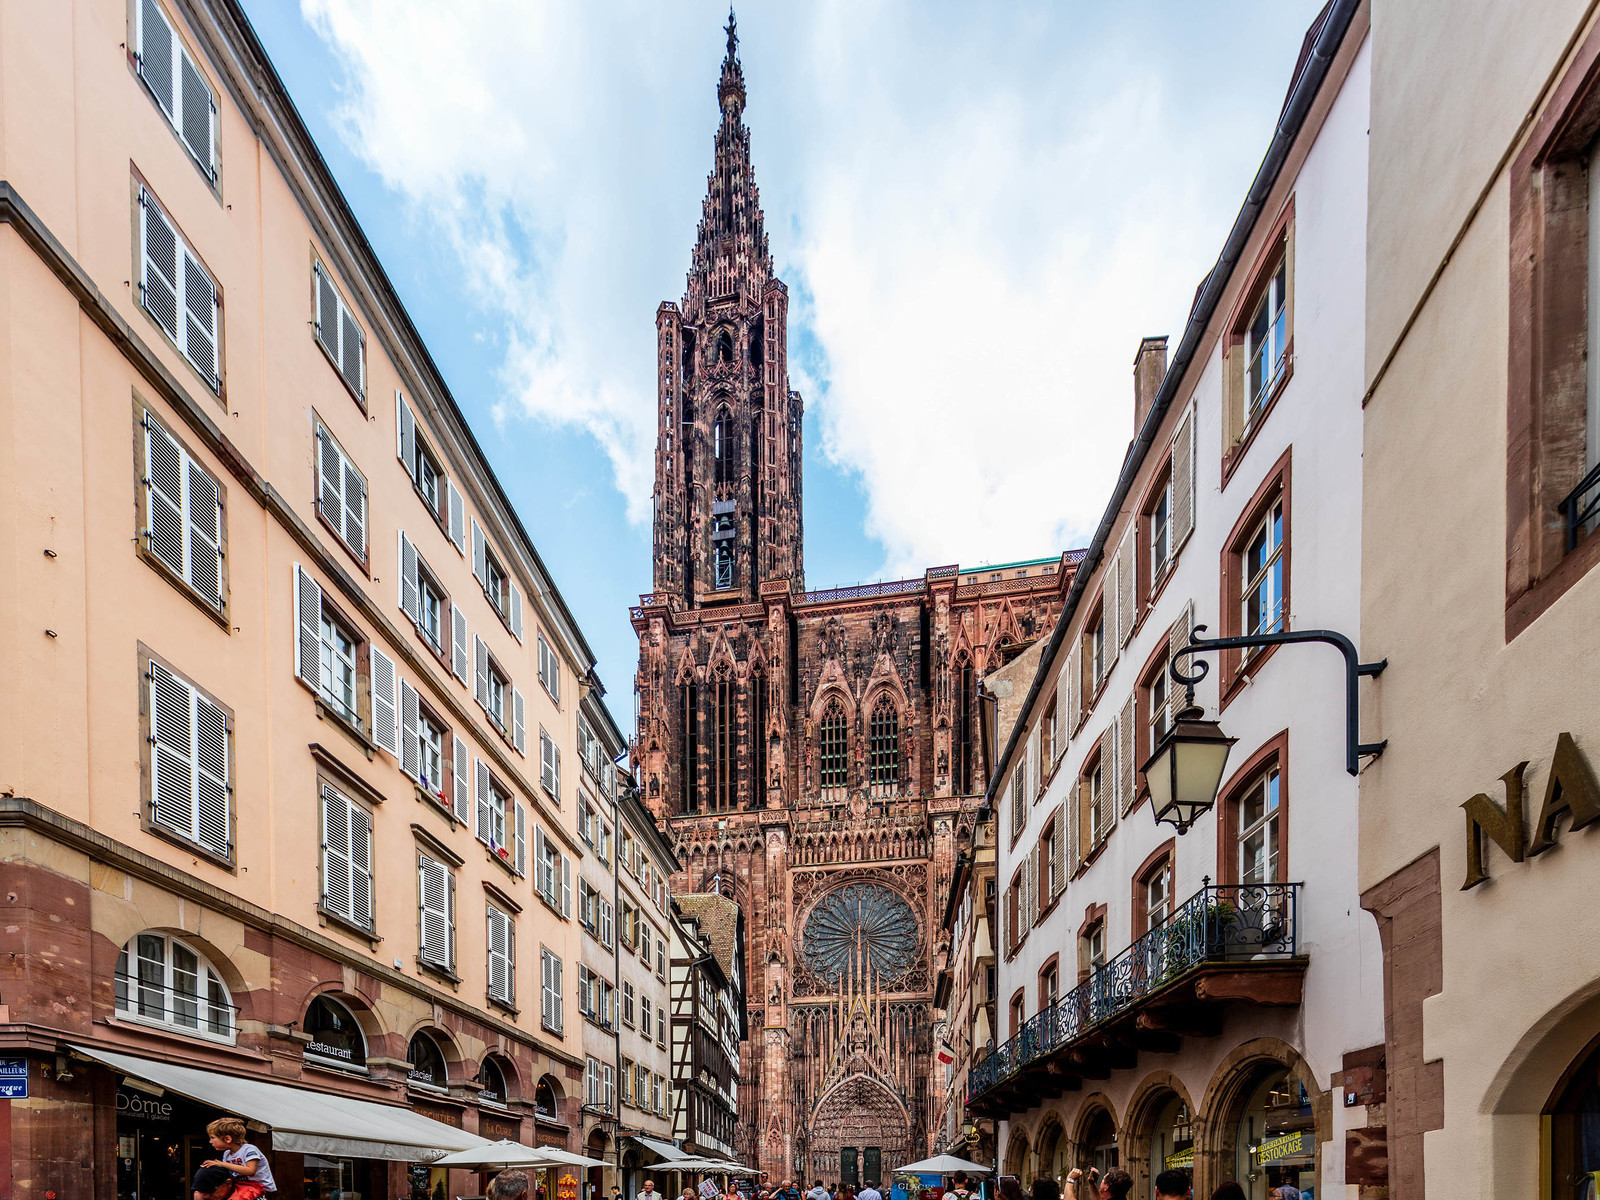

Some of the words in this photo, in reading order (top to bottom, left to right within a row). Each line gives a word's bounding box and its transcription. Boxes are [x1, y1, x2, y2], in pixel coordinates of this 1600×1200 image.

[1459, 732, 1600, 891] NA
[306, 1041, 352, 1060] restaurant
[408, 1069, 432, 1082] glacier
[116, 1094, 172, 1115] Dôme
[1257, 1139, 1303, 1165] DESTOCKAGE
